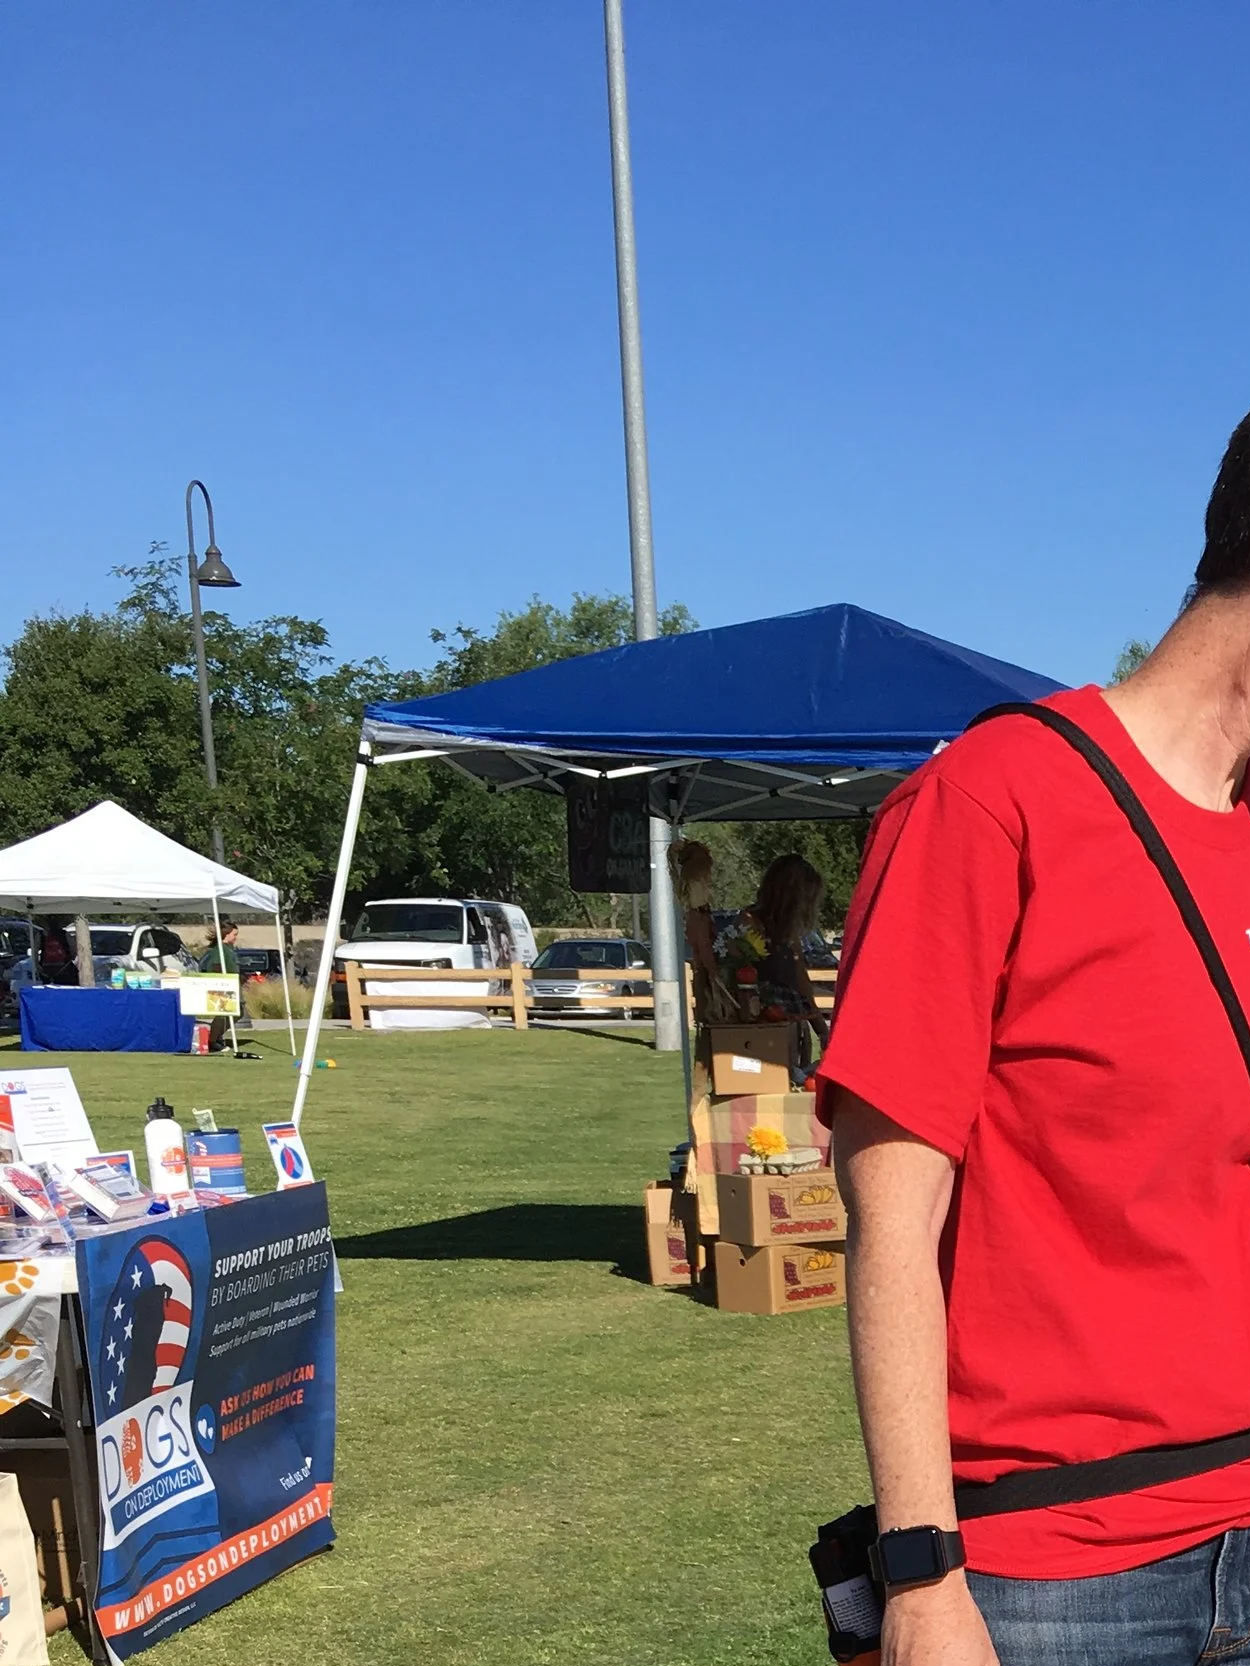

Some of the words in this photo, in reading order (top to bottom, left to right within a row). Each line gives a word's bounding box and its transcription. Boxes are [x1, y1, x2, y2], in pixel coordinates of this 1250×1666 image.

[214, 1246, 265, 1278] SUPPORT
[267, 1237, 294, 1262] YOUR
[296, 1226, 332, 1252] TROOPS
[211, 1285, 226, 1307] BY
[226, 1268, 277, 1302] BOARDING
[278, 1258, 305, 1283] THEIR
[306, 1251, 330, 1274] PETS
[220, 1392, 240, 1416] ASK
[252, 1380, 274, 1401] HOW
[292, 1364, 315, 1384] CAN
[221, 1416, 244, 1441] MAKE
[244, 1413, 251, 1428] A
[251, 1388, 304, 1424] DIFFERENCE
[124, 1499, 138, 1519] ON
[138, 1464, 201, 1510] DEPLOYMENT
[279, 1472, 295, 1491] Find
[294, 1469, 303, 1483] us
